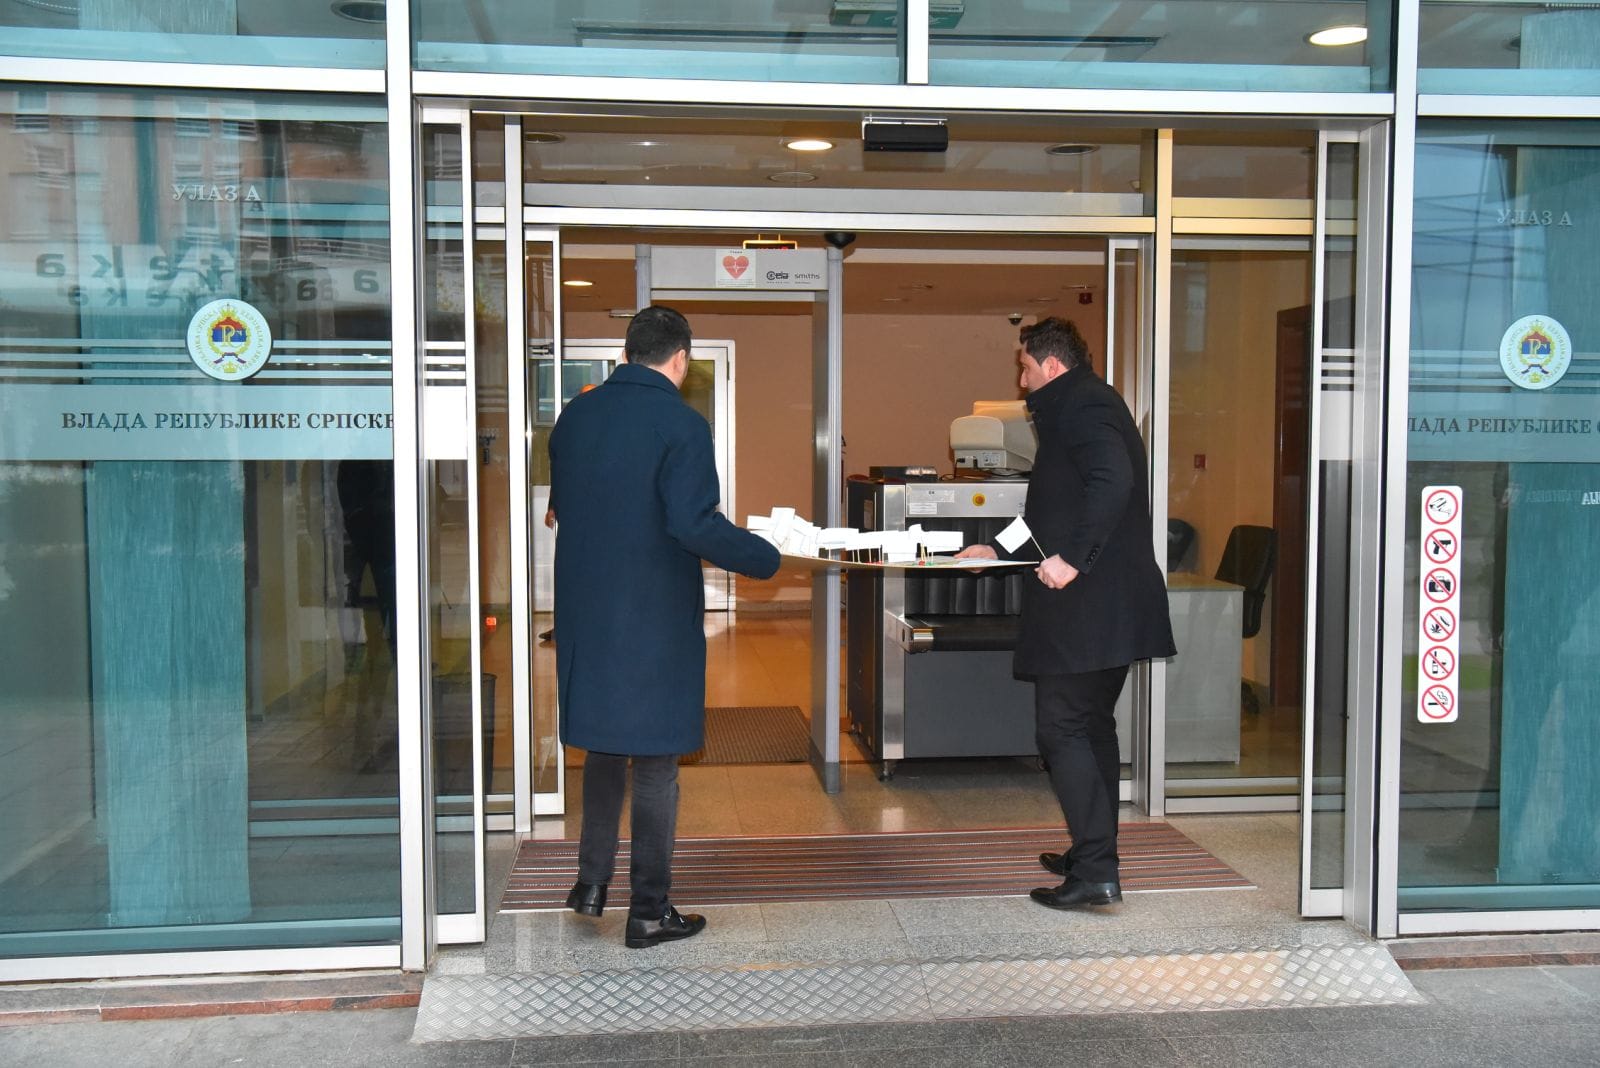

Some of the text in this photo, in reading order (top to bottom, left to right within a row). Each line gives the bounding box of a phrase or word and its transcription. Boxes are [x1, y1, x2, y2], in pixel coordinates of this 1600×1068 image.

[171, 183, 262, 202] УЛАЗ А
[1496, 208, 1573, 226] УЛАЗ А
[61, 412, 148, 432] ВЛАДА
[154, 412, 301, 429] РЕПУБЛИКЕ
[1408, 417, 1461, 436] ЛАДА
[1467, 418, 1592, 434] РЕПУБЛИКЕ
